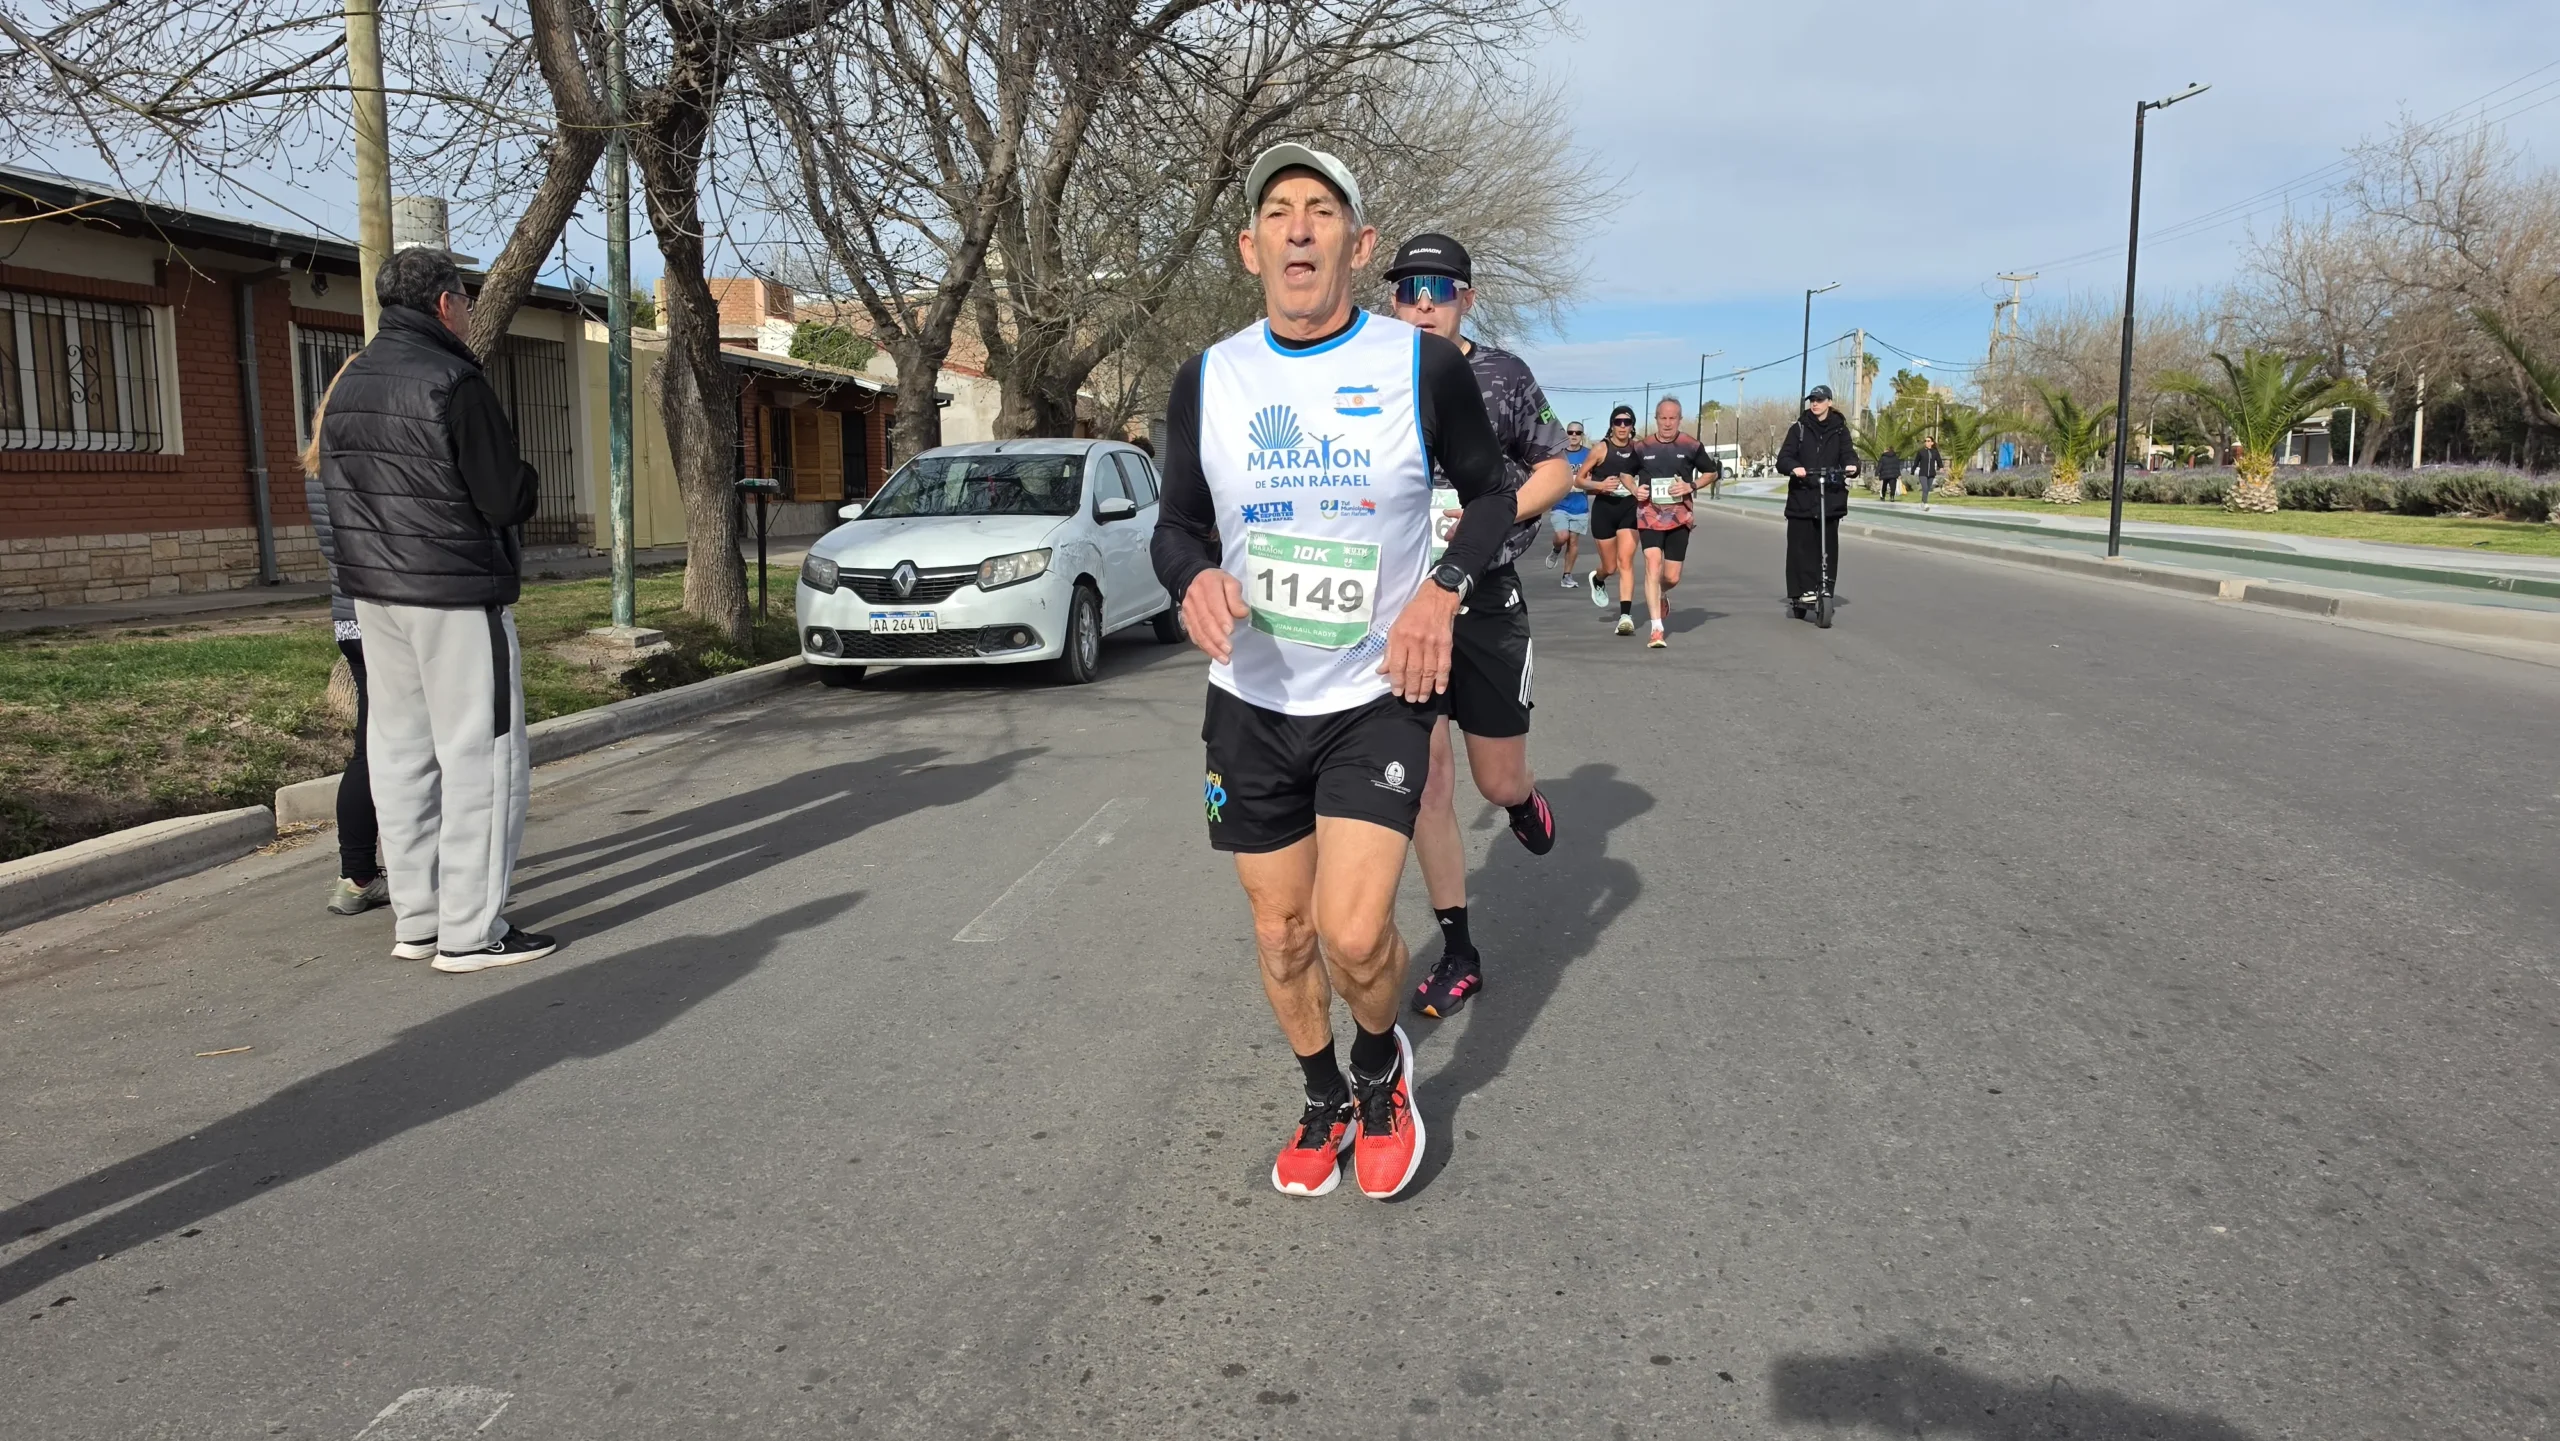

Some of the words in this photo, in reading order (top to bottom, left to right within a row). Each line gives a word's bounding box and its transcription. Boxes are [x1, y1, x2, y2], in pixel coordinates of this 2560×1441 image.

[1408, 247, 1442, 256] SALOMON
[1247, 447, 1371, 473] MARATON
[1255, 480, 1266, 489] DE
[1270, 475, 1304, 488] SAN
[1309, 474, 1371, 487] RAFAEL
[1654, 486, 1666, 496] 11
[1258, 501, 1293, 513] UTN
[1292, 544, 1331, 562] 10K
[1257, 568, 1364, 613] 1149
[873, 619, 888, 631] AA
[892, 618, 915, 631] 264
[919, 618, 934, 631] VU
[1275, 622, 1292, 631] JUAN
[1293, 626, 1312, 634] RAUL
[1313, 629, 1337, 638] RADYS
